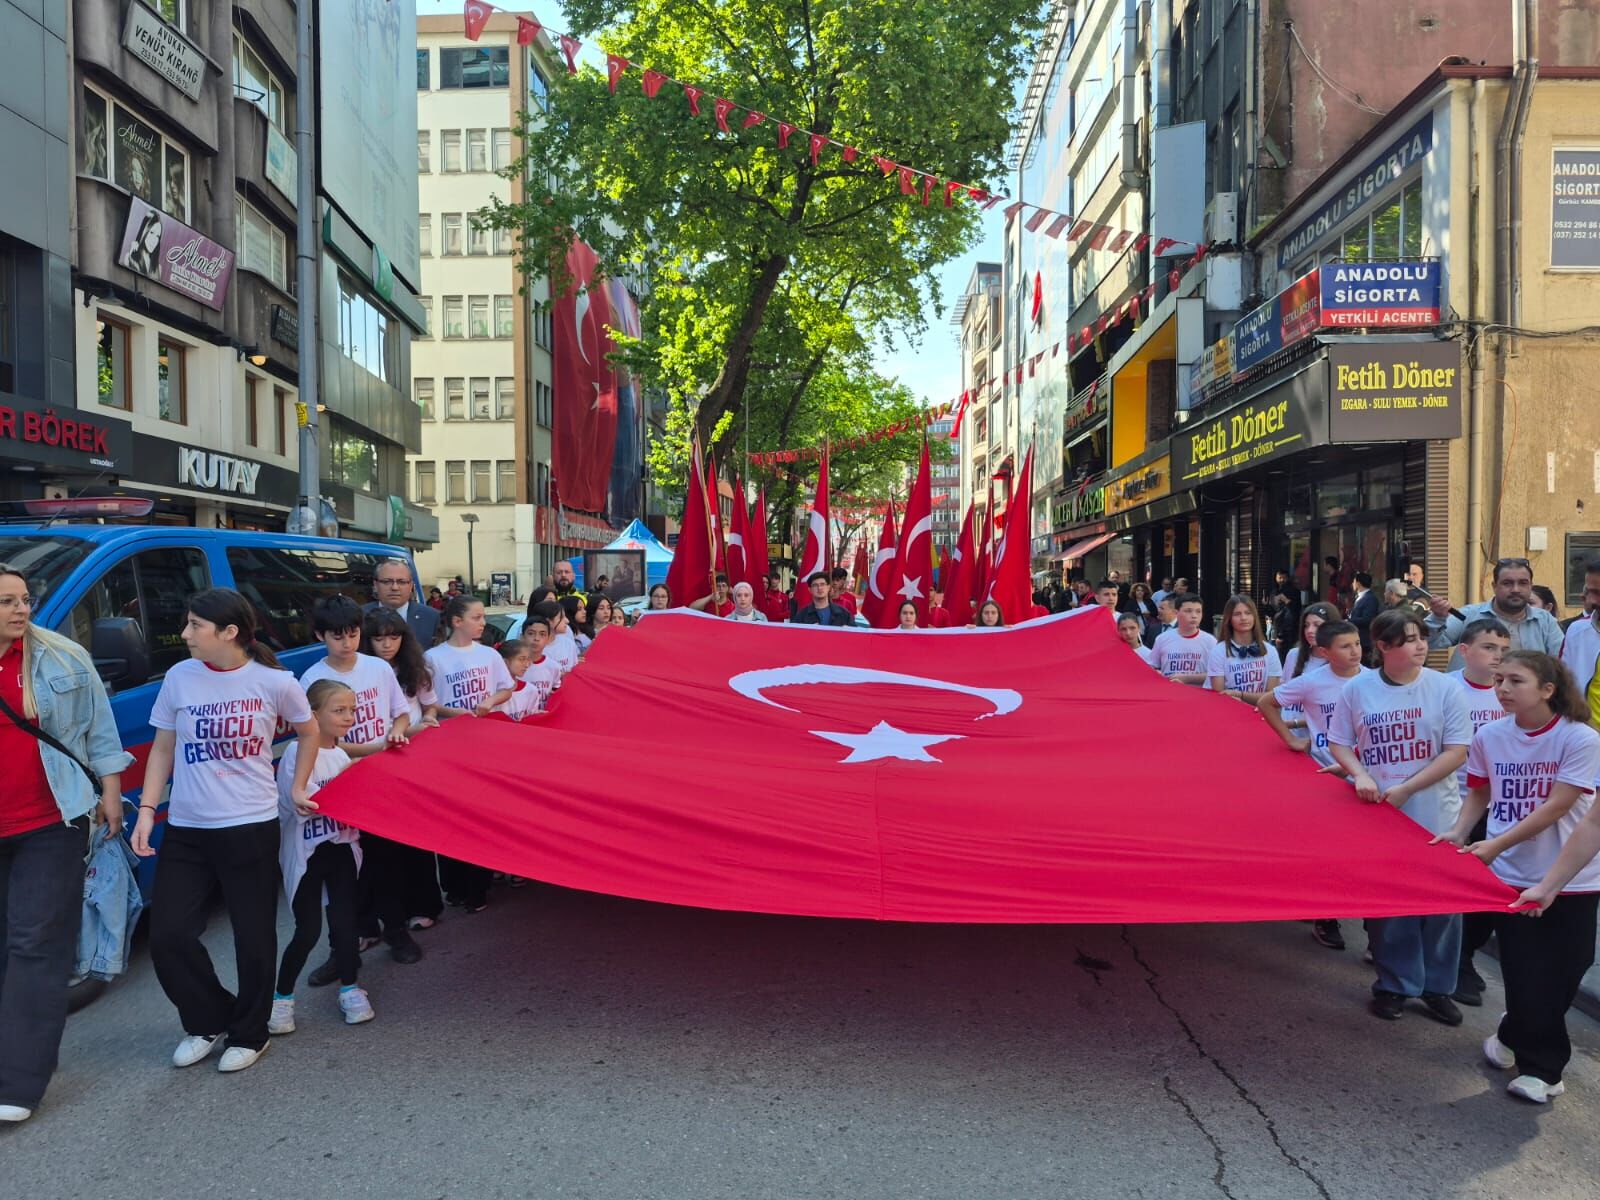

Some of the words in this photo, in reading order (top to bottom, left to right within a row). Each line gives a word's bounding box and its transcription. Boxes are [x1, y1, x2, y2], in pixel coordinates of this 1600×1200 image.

[135, 25, 166, 57] VENÜS
[157, 26, 187, 55] AVUKAT
[117, 122, 155, 153] Ahmet
[1281, 199, 1342, 265] ANADOLU
[1346, 133, 1423, 211] SİGORTA
[165, 235, 227, 280] Ahmet
[1334, 266, 1428, 282] ANADOLU
[1334, 285, 1421, 303] SİGORTA
[1239, 306, 1272, 339] ANADOLU
[1330, 309, 1379, 324] YETKİLİ
[1382, 312, 1432, 323] ACENTE
[1240, 330, 1271, 360] SİGORTA
[1337, 362, 1387, 391] Fetih
[1392, 361, 1455, 389] Döner
[1341, 398, 1367, 410] IZGARA
[1373, 397, 1391, 409] SULU
[1392, 396, 1417, 408] YEMEK
[1422, 393, 1449, 408] DÖNER
[23, 407, 111, 456] BÖREK
[1191, 420, 1227, 465] Fetih
[1231, 400, 1288, 449] Döner
[1253, 440, 1274, 458] DÖNER
[178, 446, 261, 495] KUTAY
[452, 676, 486, 699] GÜCÜ
[1234, 669, 1263, 685] GÜCÜ
[195, 715, 254, 739] GÜCÜ
[1369, 722, 1416, 746] GÜCÜ
[184, 736, 264, 765] GENÇLİĞİ
[1362, 738, 1432, 767] GENÇLİĞİ
[1501, 777, 1553, 800] GÜCÜ
